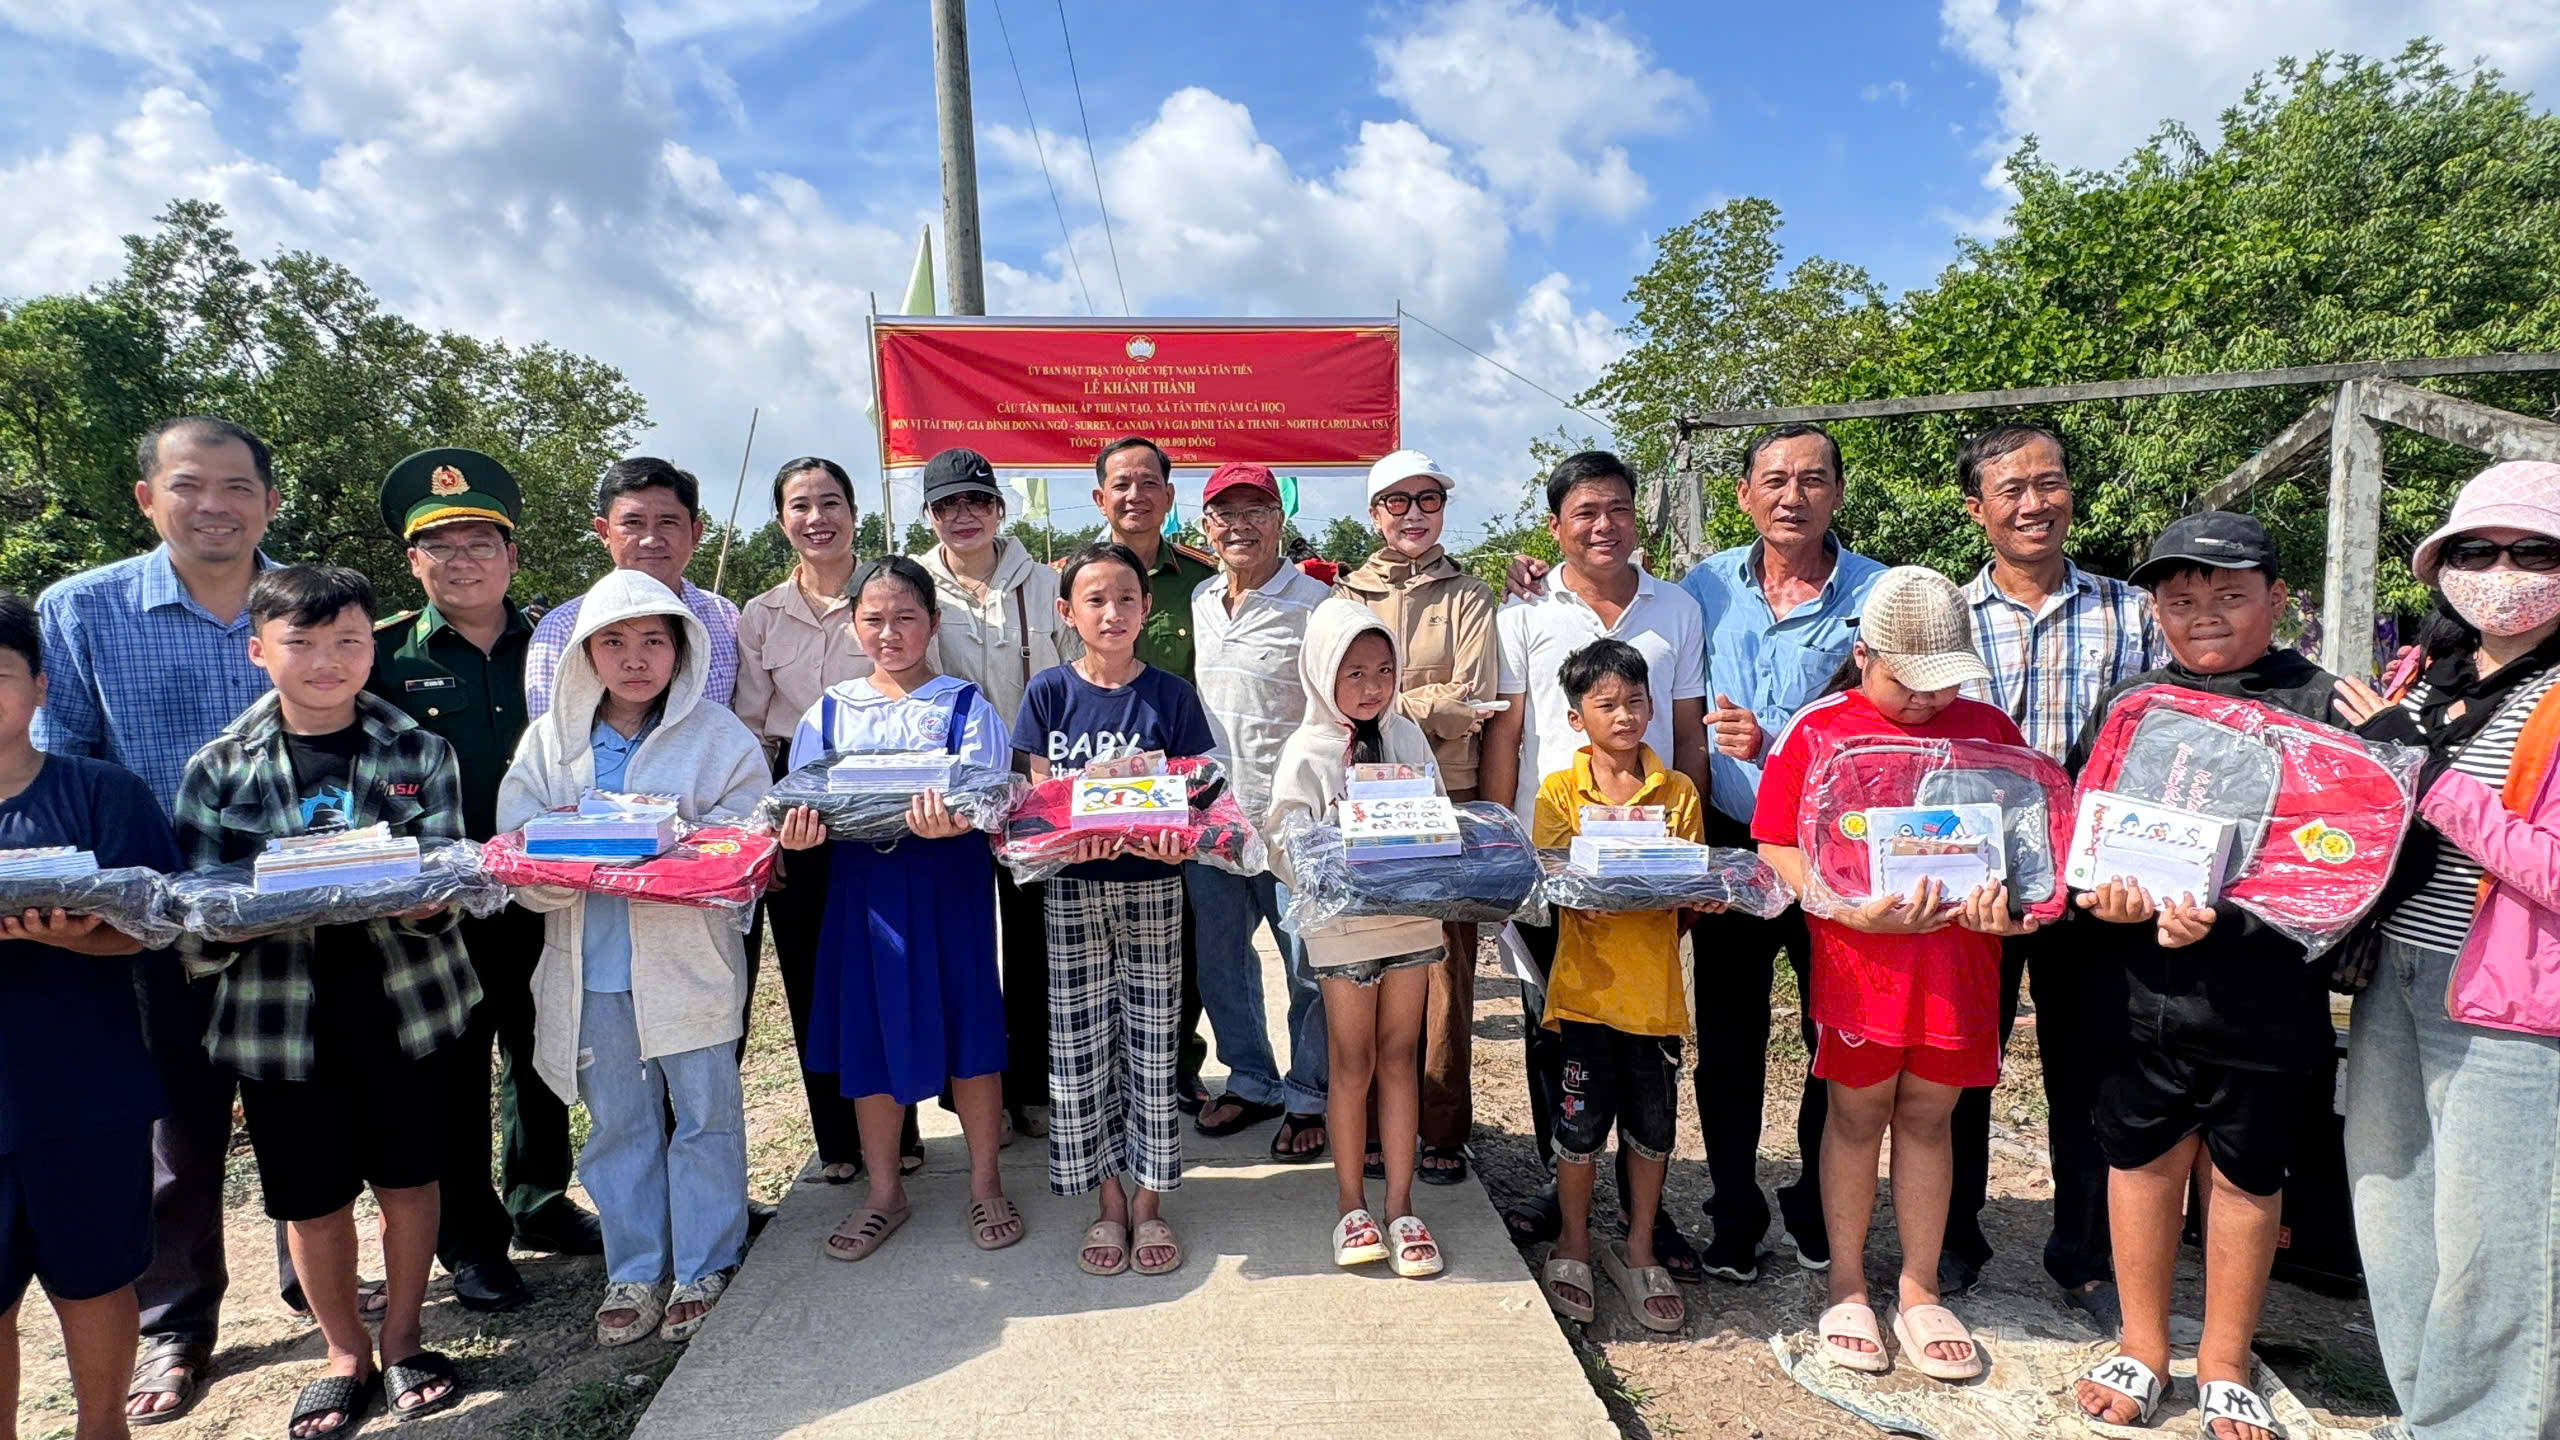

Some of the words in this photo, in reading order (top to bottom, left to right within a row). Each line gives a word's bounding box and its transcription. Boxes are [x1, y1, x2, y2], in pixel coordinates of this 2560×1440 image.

[1042, 366, 1060, 376] BAN
[1062, 365, 1082, 377] MẶT
[1085, 365, 1109, 377] TRẬN
[1125, 363, 1151, 377] QUỐC
[1153, 364, 1173, 378] VIỆT
[1175, 366, 1196, 376] NAM
[1198, 364, 1210, 376] XÃ
[1084, 378, 1100, 394] LỄ
[1103, 378, 1149, 394] KHÁNH
[1151, 378, 1196, 394] THÀNH
[1041, 403, 1078, 415] THANH,
[1094, 402, 1128, 415] THUẬN
[1156, 401, 1171, 414] XÃ
[1172, 401, 1192, 414] TÂN
[911, 419, 921, 431] VỊ
[922, 417, 940, 430] TÀI
[967, 420, 985, 431] GIA
[986, 417, 1010, 431] ĐÌNH
[1012, 420, 1046, 431] DONNA
[1047, 417, 1068, 431] NGÔ
[1074, 420, 1115, 432] SURREY,
[1116, 420, 1155, 431] CANADA
[1157, 417, 1171, 430] VÀ
[1172, 419, 1189, 430] GIA
[1191, 417, 1214, 430] ĐÌNH
[1237, 419, 1245, 429] &
[1247, 419, 1280, 430] THANH
[1286, 419, 1318, 429] NORTH
[1372, 418, 1389, 430] USA
[1188, 434, 1216, 448] ĐỒNG
